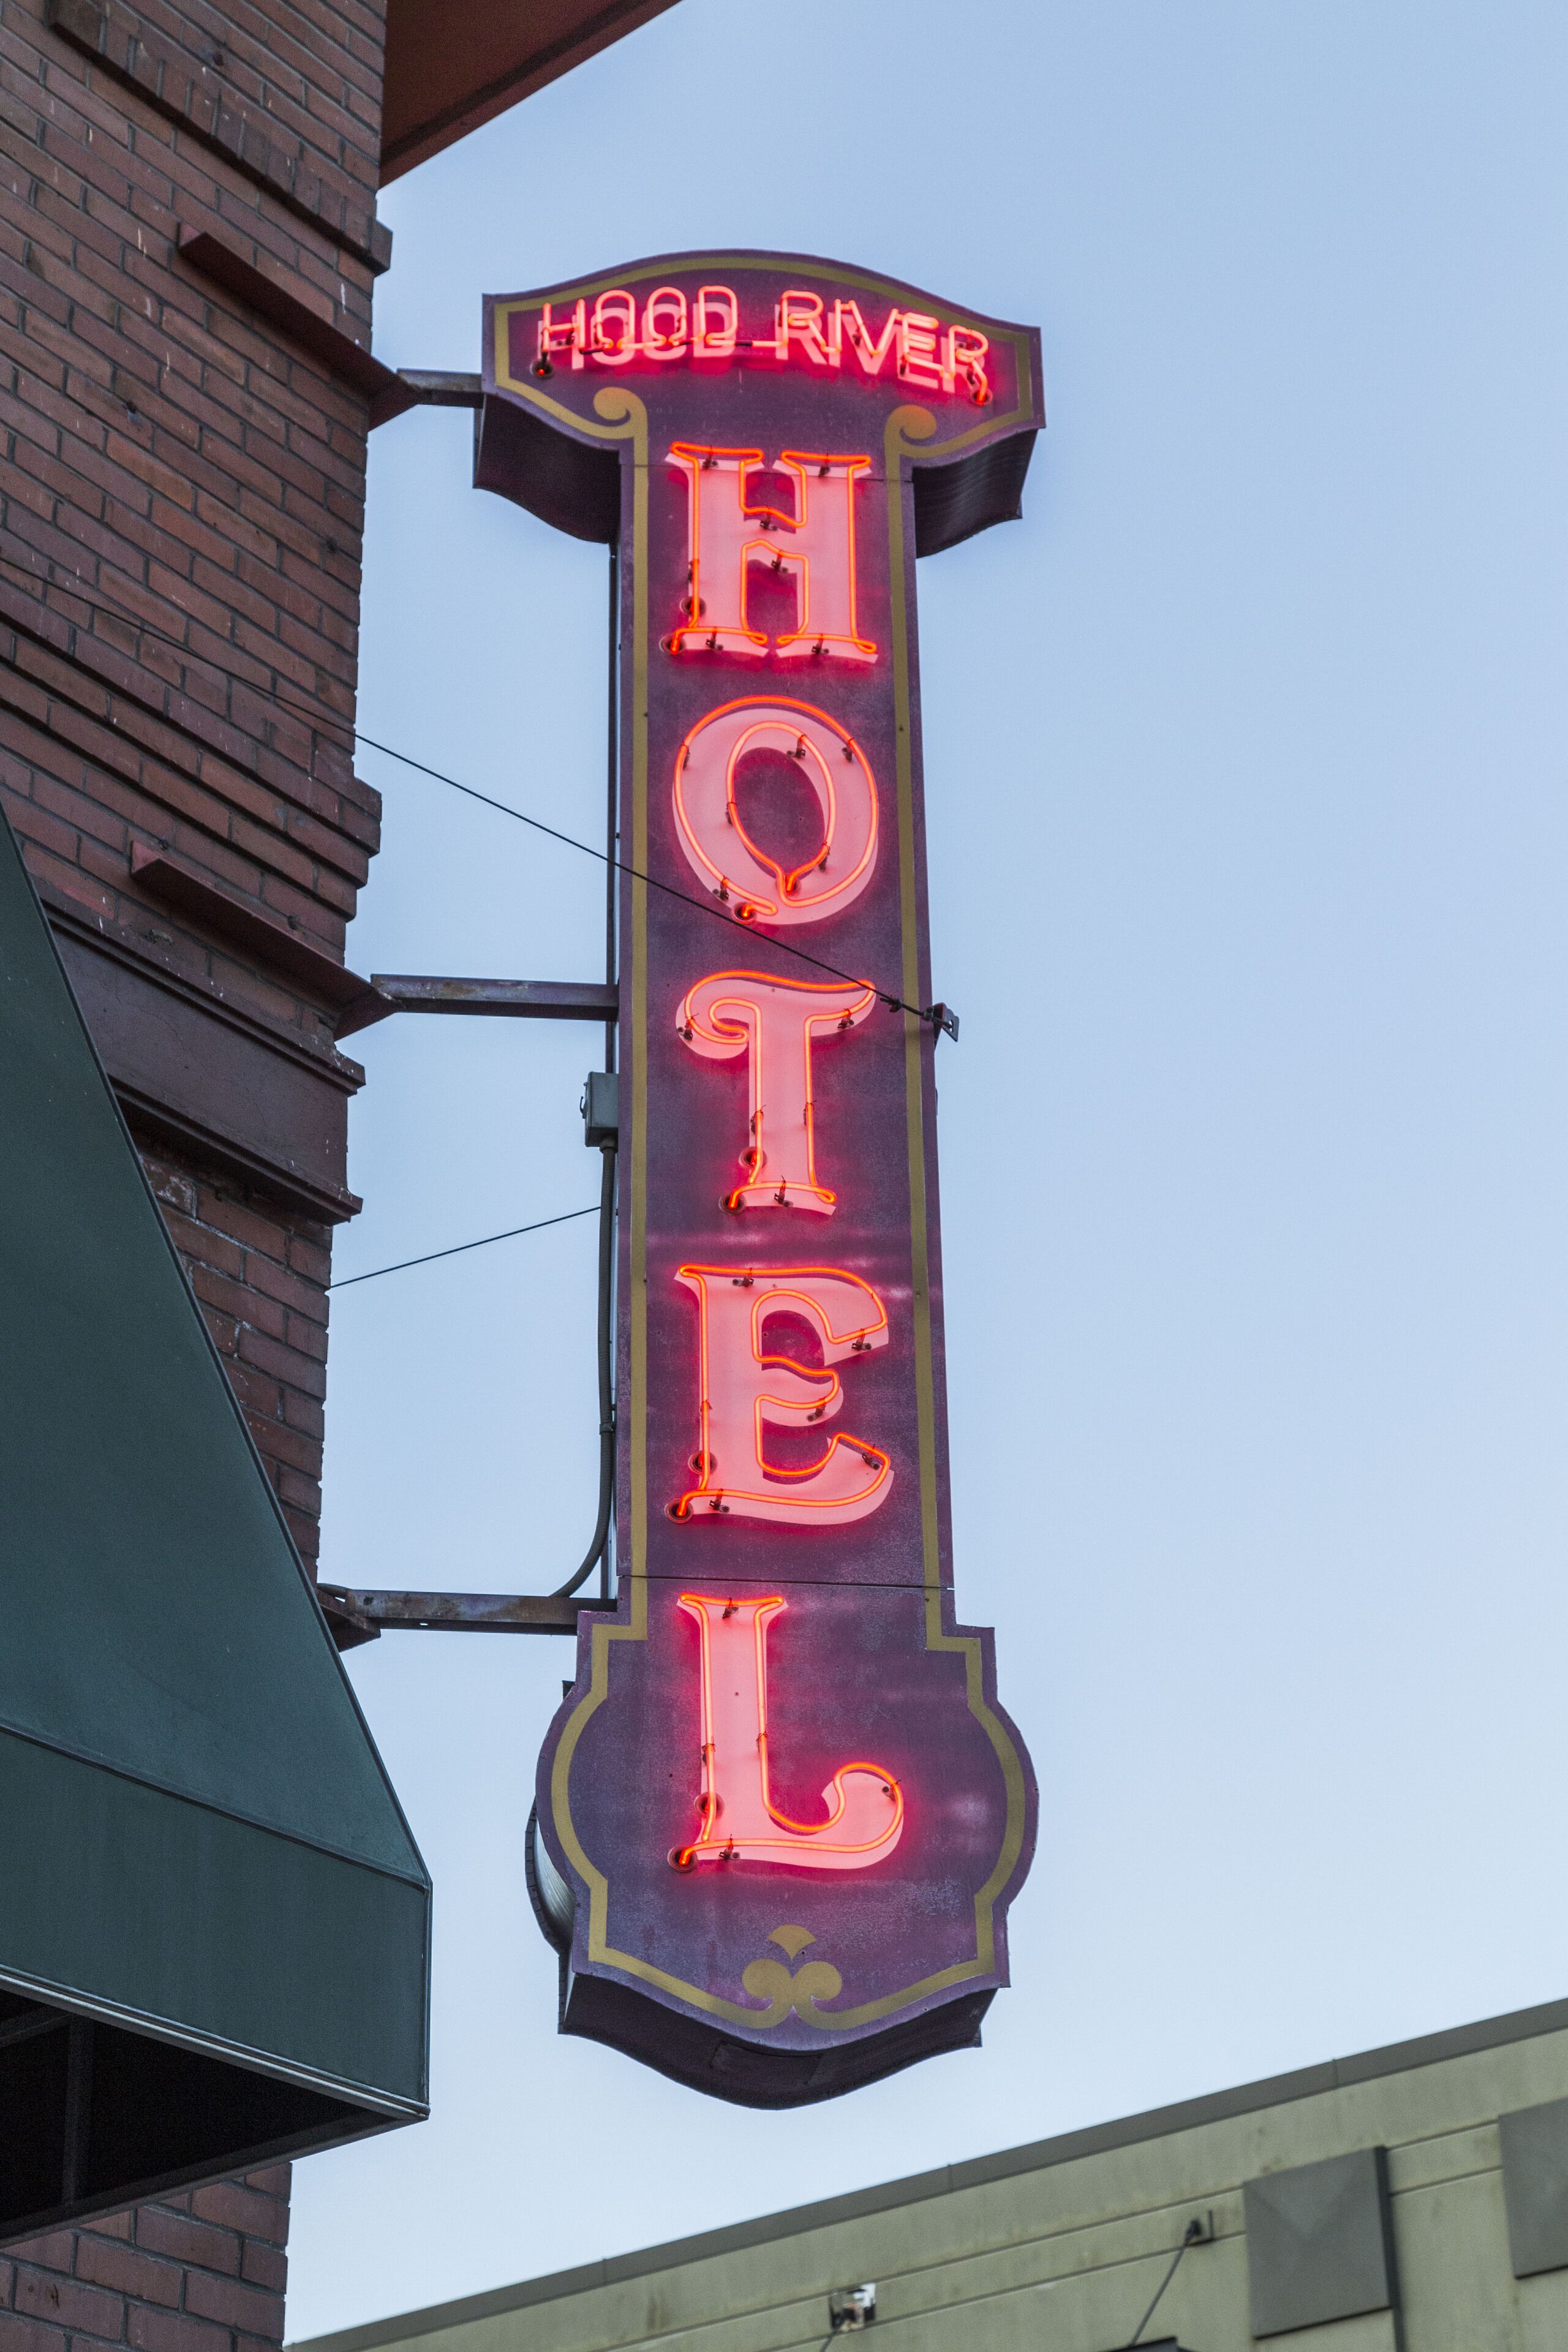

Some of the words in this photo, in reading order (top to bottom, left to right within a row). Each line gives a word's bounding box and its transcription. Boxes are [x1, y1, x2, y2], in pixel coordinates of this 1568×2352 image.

[537, 285, 739, 369] HOOD
[775, 289, 990, 396] RIVER
[664, 441, 904, 1870] HOTEL
